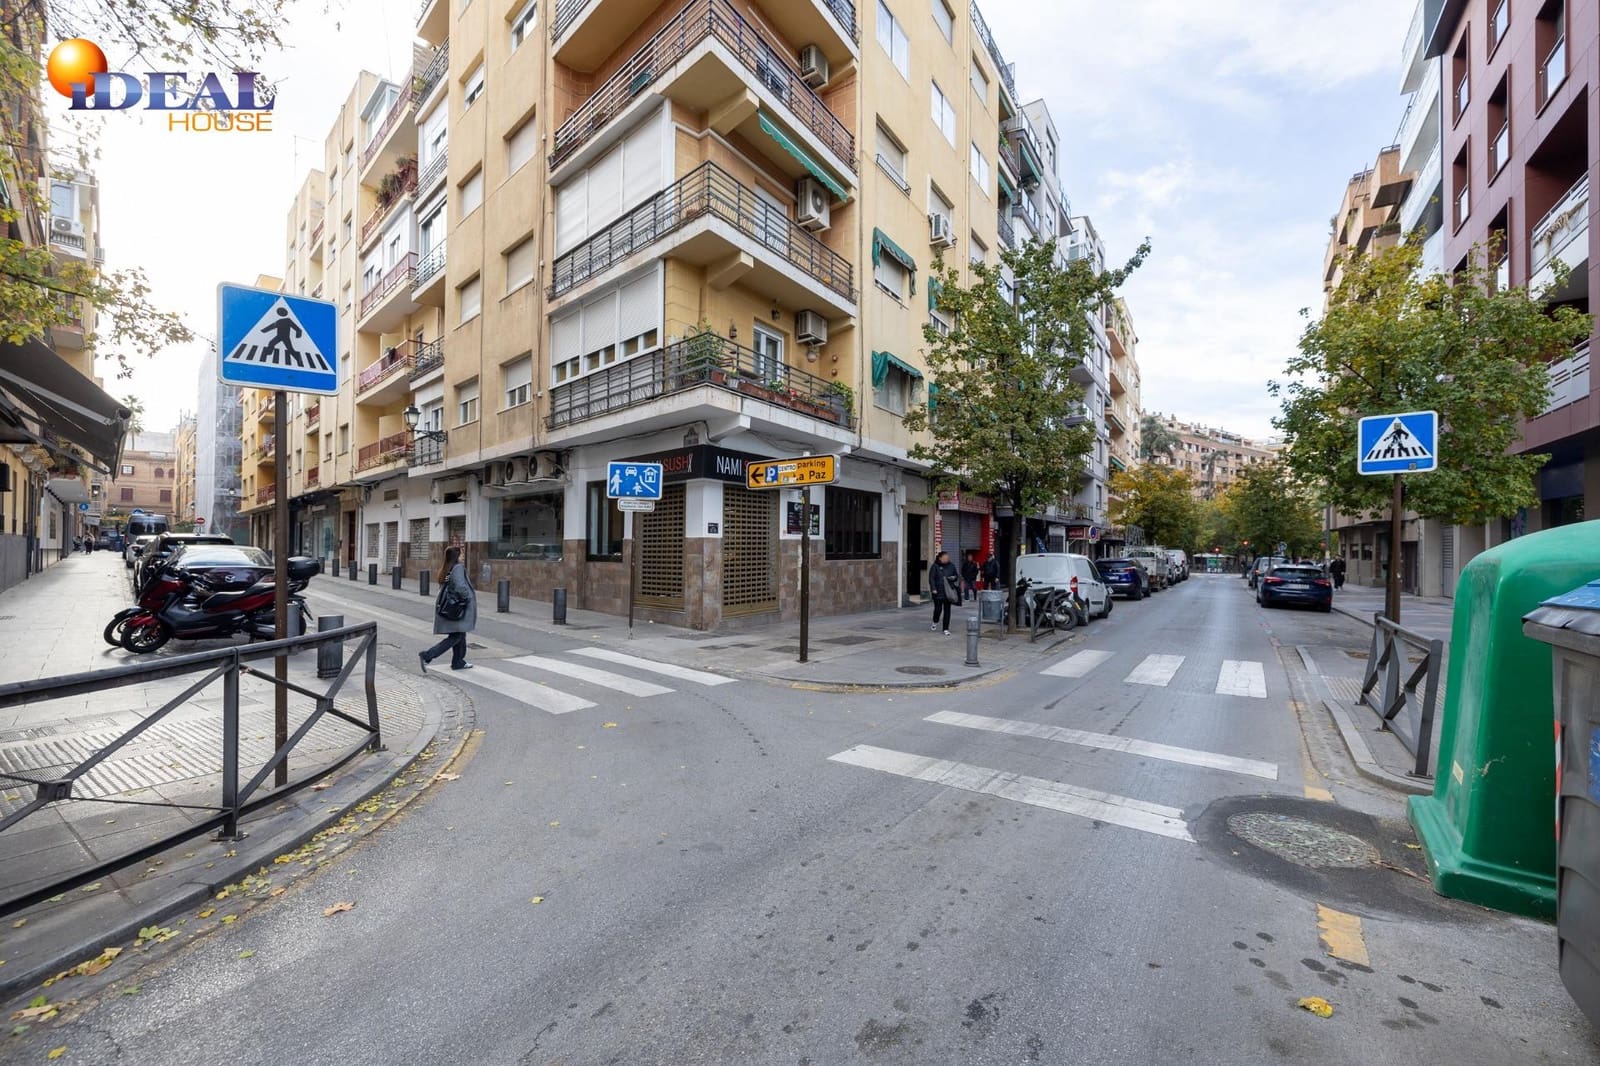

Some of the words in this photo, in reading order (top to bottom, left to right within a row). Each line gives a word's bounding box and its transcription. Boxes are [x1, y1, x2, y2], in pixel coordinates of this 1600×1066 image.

[716, 455, 742, 477] NAMI
[797, 460, 826, 470] parking
[808, 470, 826, 481] Paz
